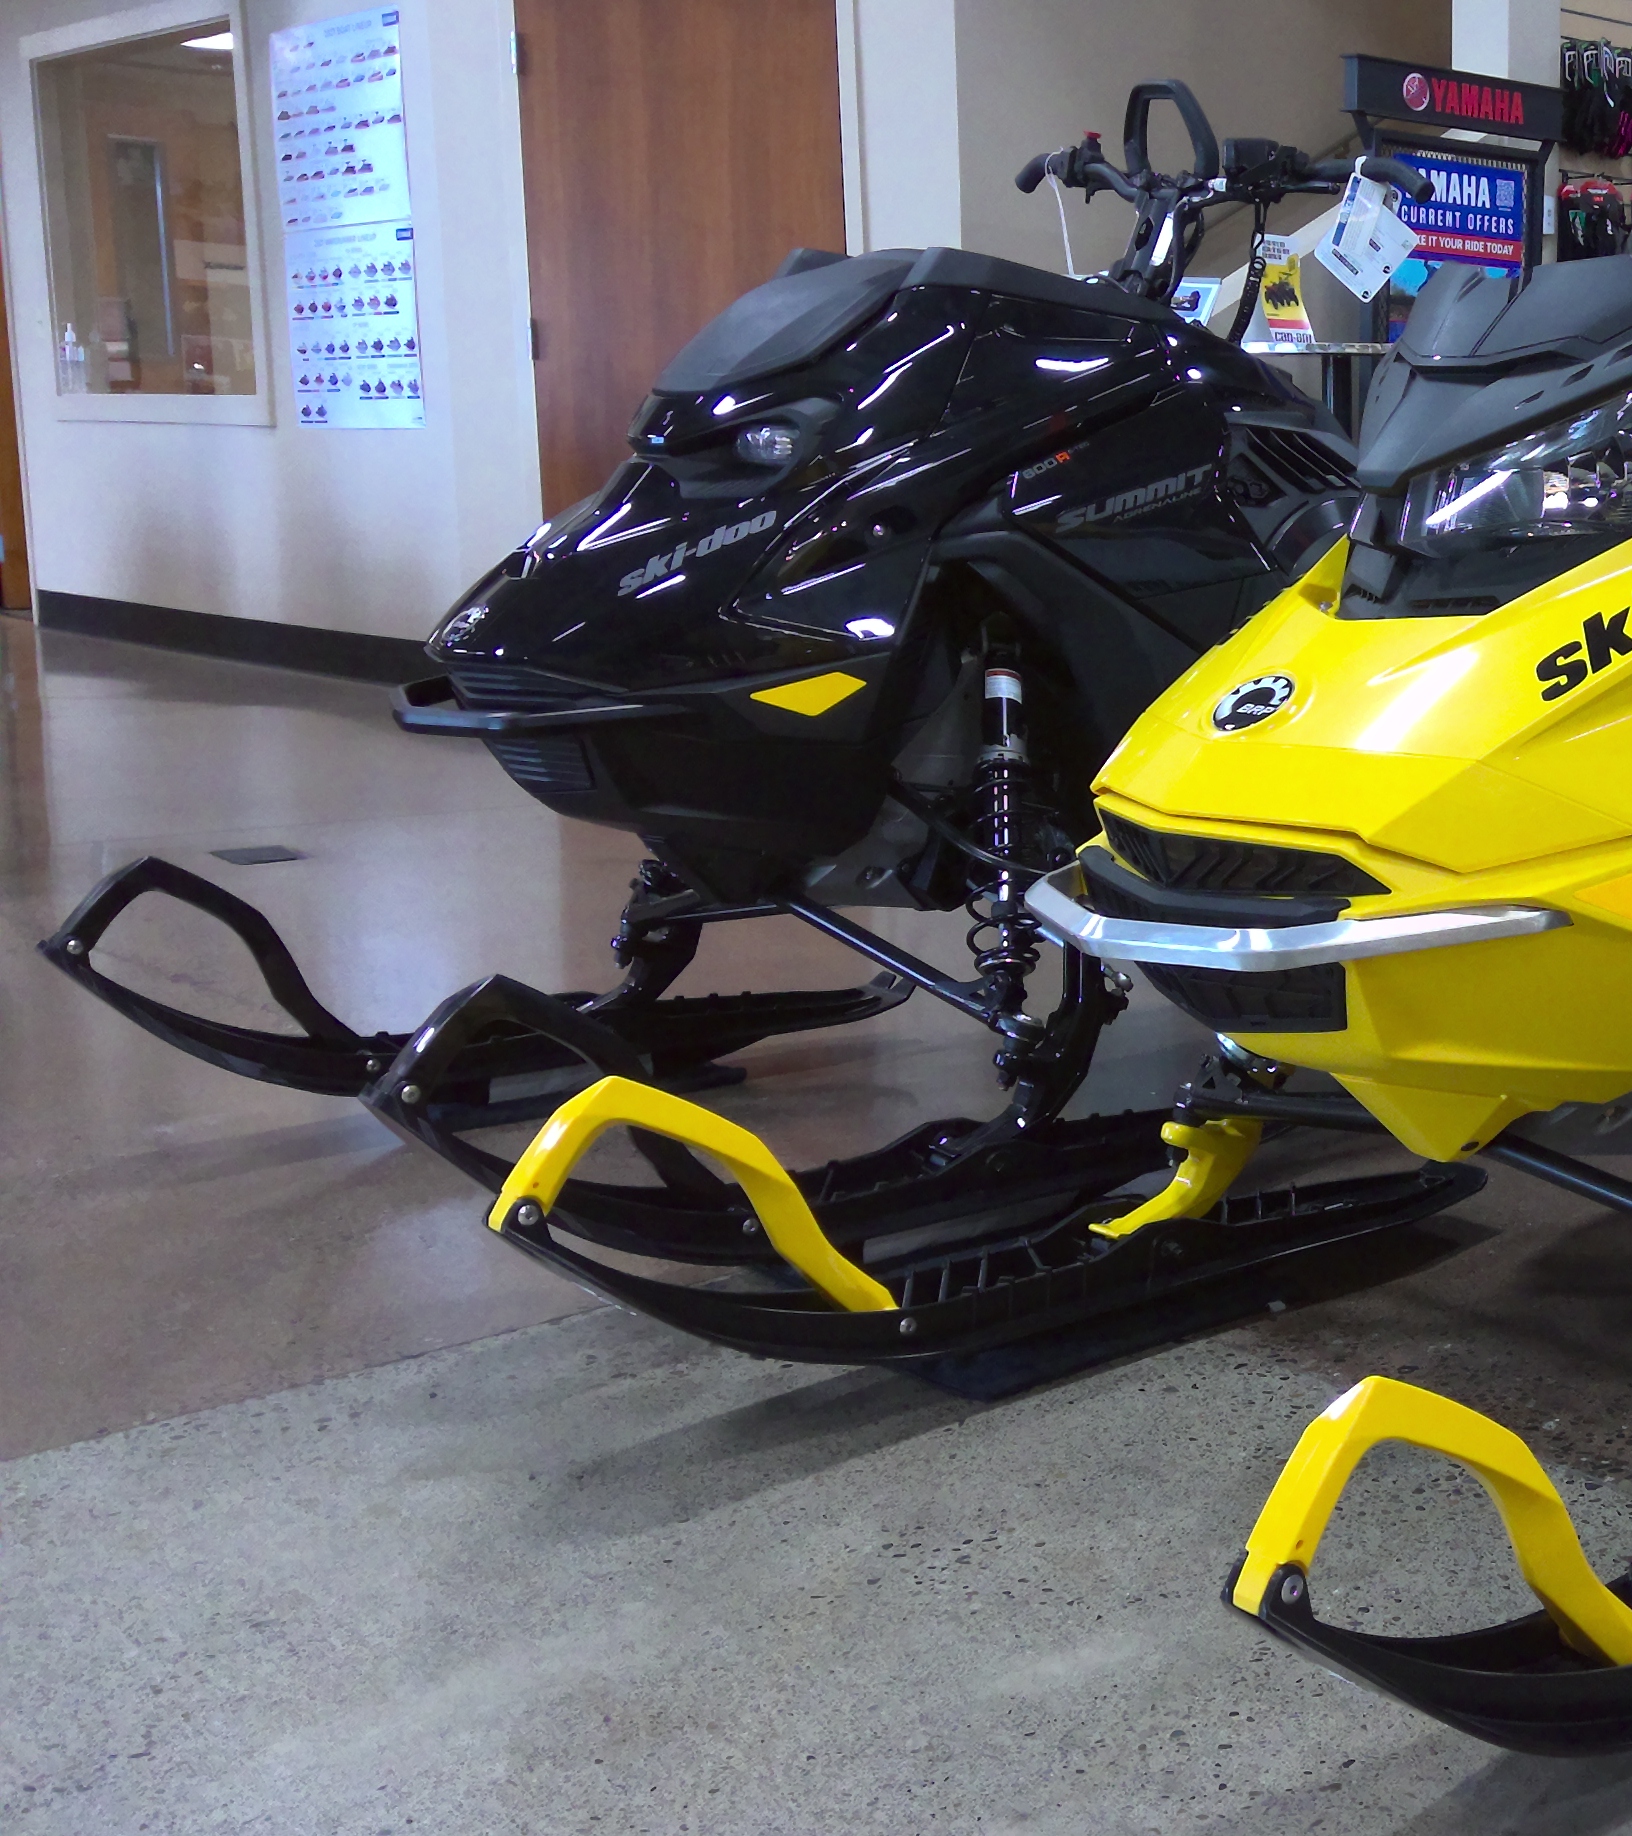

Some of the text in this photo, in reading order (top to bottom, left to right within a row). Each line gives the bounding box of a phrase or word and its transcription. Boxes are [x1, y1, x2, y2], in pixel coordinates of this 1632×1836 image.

[1432, 77, 1524, 124] YAMAHA
[1406, 166, 1491, 208] MAHA
[1401, 205, 1514, 235] CURRENT OFFERS
[1429, 235, 1437, 247] IT
[1439, 236, 1463, 251] YOUR
[1465, 240, 1484, 252] RIDE
[1487, 242, 1514, 255] TODAY
[1023, 451, 1070, 479] 600R
[1055, 464, 1212, 534] SUMMIT
[617, 510, 777, 597] ski-doo
[1236, 703, 1277, 715] BRP
